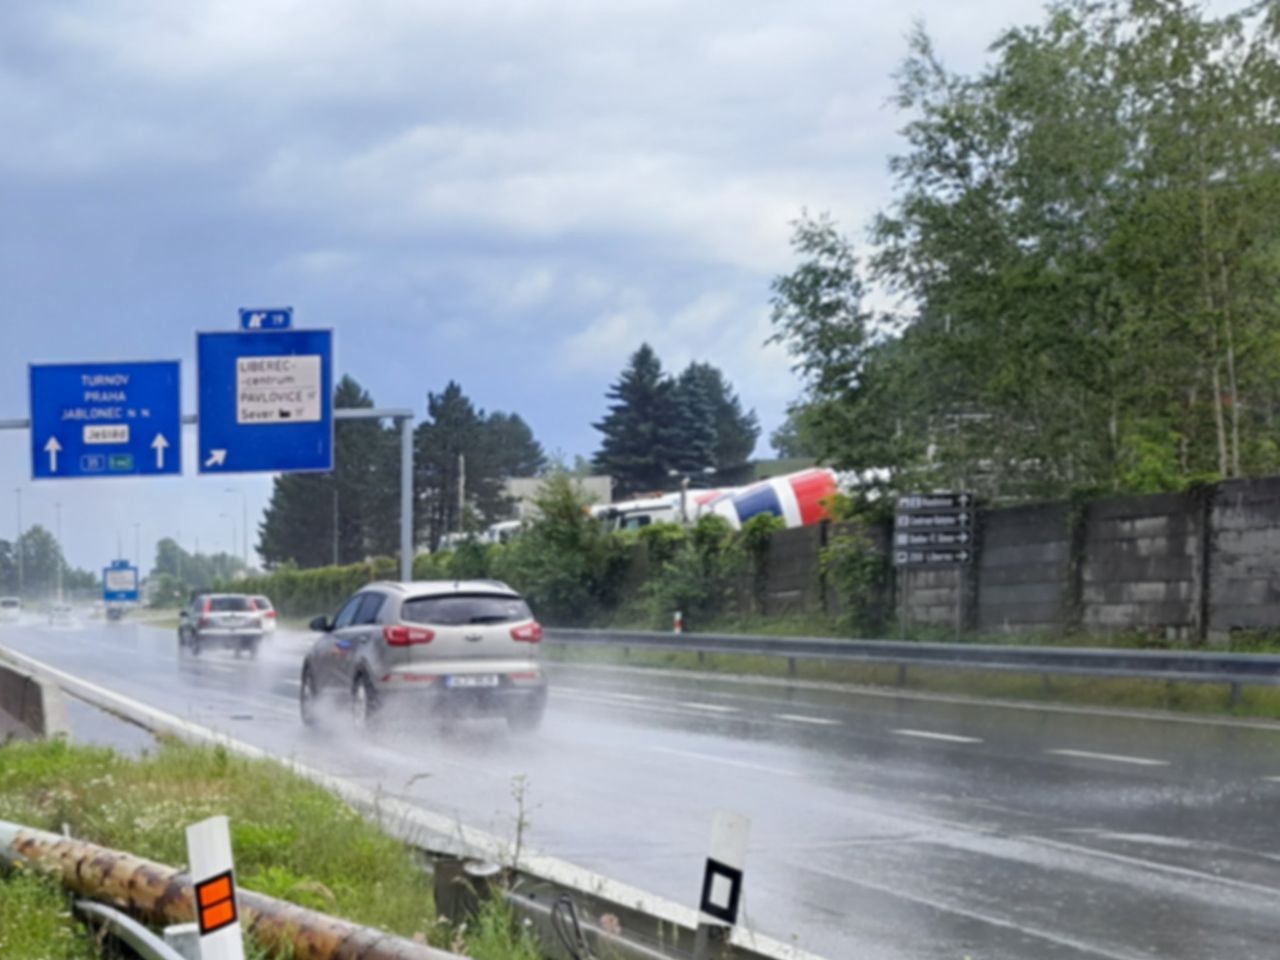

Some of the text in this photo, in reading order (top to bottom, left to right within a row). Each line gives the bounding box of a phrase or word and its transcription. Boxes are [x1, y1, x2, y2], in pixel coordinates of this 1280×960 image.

[81, 374, 129, 386] TURNOV
[84, 391, 127, 402] PRAHA
[240, 391, 303, 403] PAVLOVICE
[61, 407, 123, 420] JABLONEC
[241, 408, 275, 420] Sever
